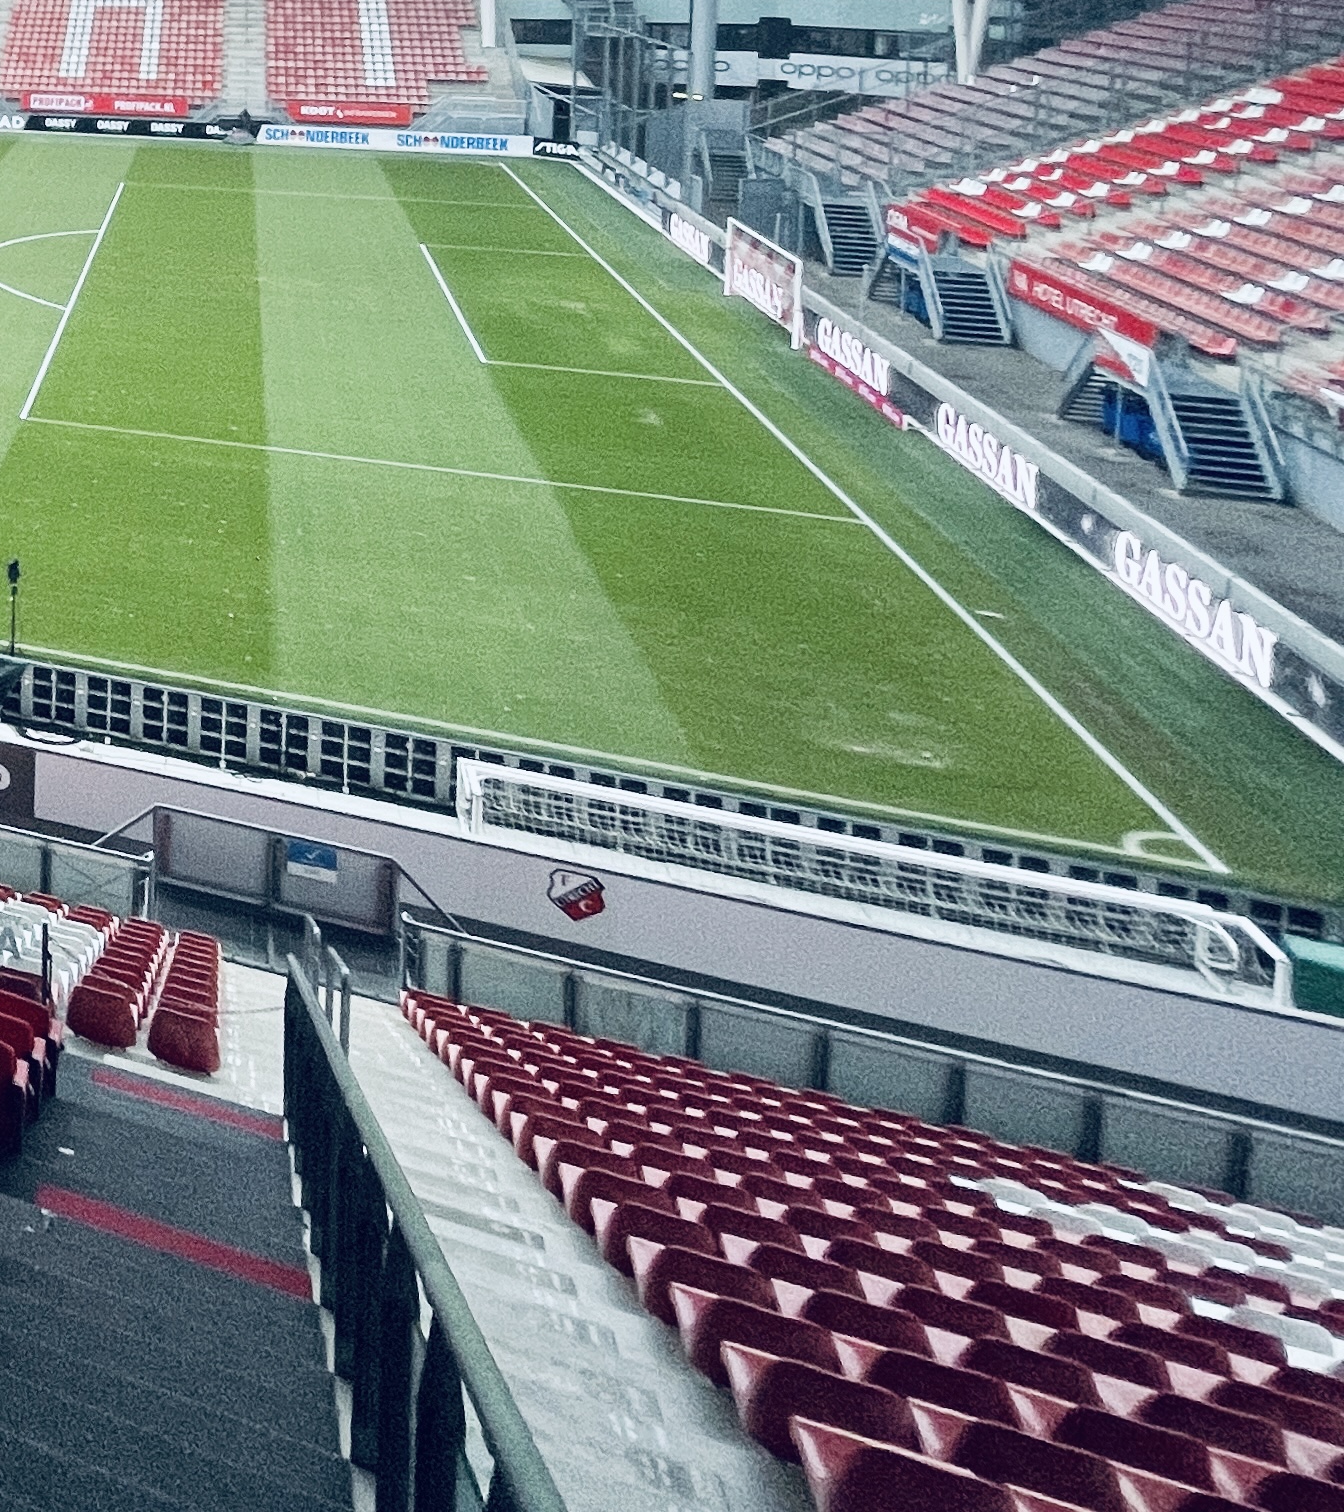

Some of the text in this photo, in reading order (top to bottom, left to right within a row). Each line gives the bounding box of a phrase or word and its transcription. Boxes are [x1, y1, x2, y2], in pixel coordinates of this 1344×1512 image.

[781, 62, 854, 80] oppo
[32, 96, 83, 107] PROFIPACK
[535, 141, 579, 156] STIGA
[817, 317, 891, 396] GASSAN
[937, 402, 1040, 509] GASSAN
[1114, 530, 1278, 688] GASSAN
